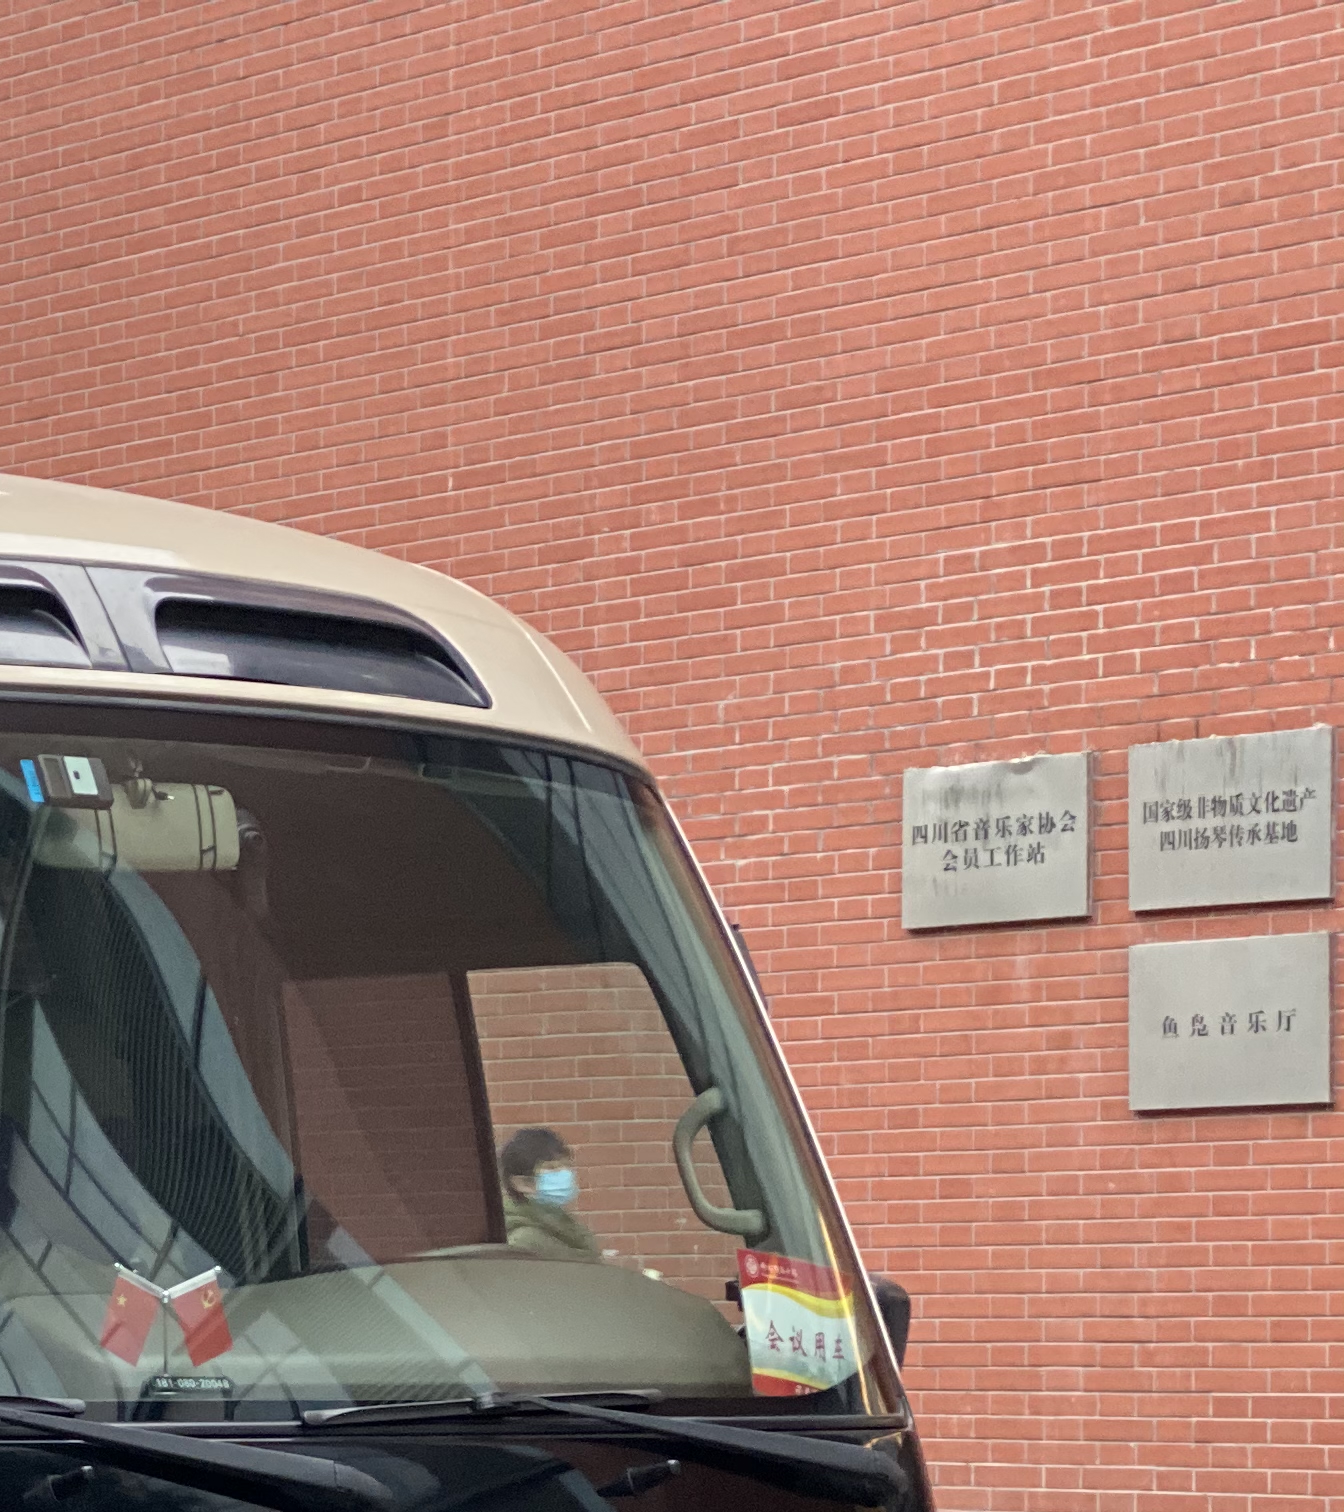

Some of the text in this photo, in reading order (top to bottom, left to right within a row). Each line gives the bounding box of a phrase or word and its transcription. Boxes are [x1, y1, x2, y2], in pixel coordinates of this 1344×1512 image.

[1143, 788, 1316, 824] 国家级非物质文化遗产
[912, 810, 1077, 845] 四川省音乐家协会
[1160, 820, 1298, 851] 四川扬琴传承基地
[943, 842, 1045, 872] 会员工作站
